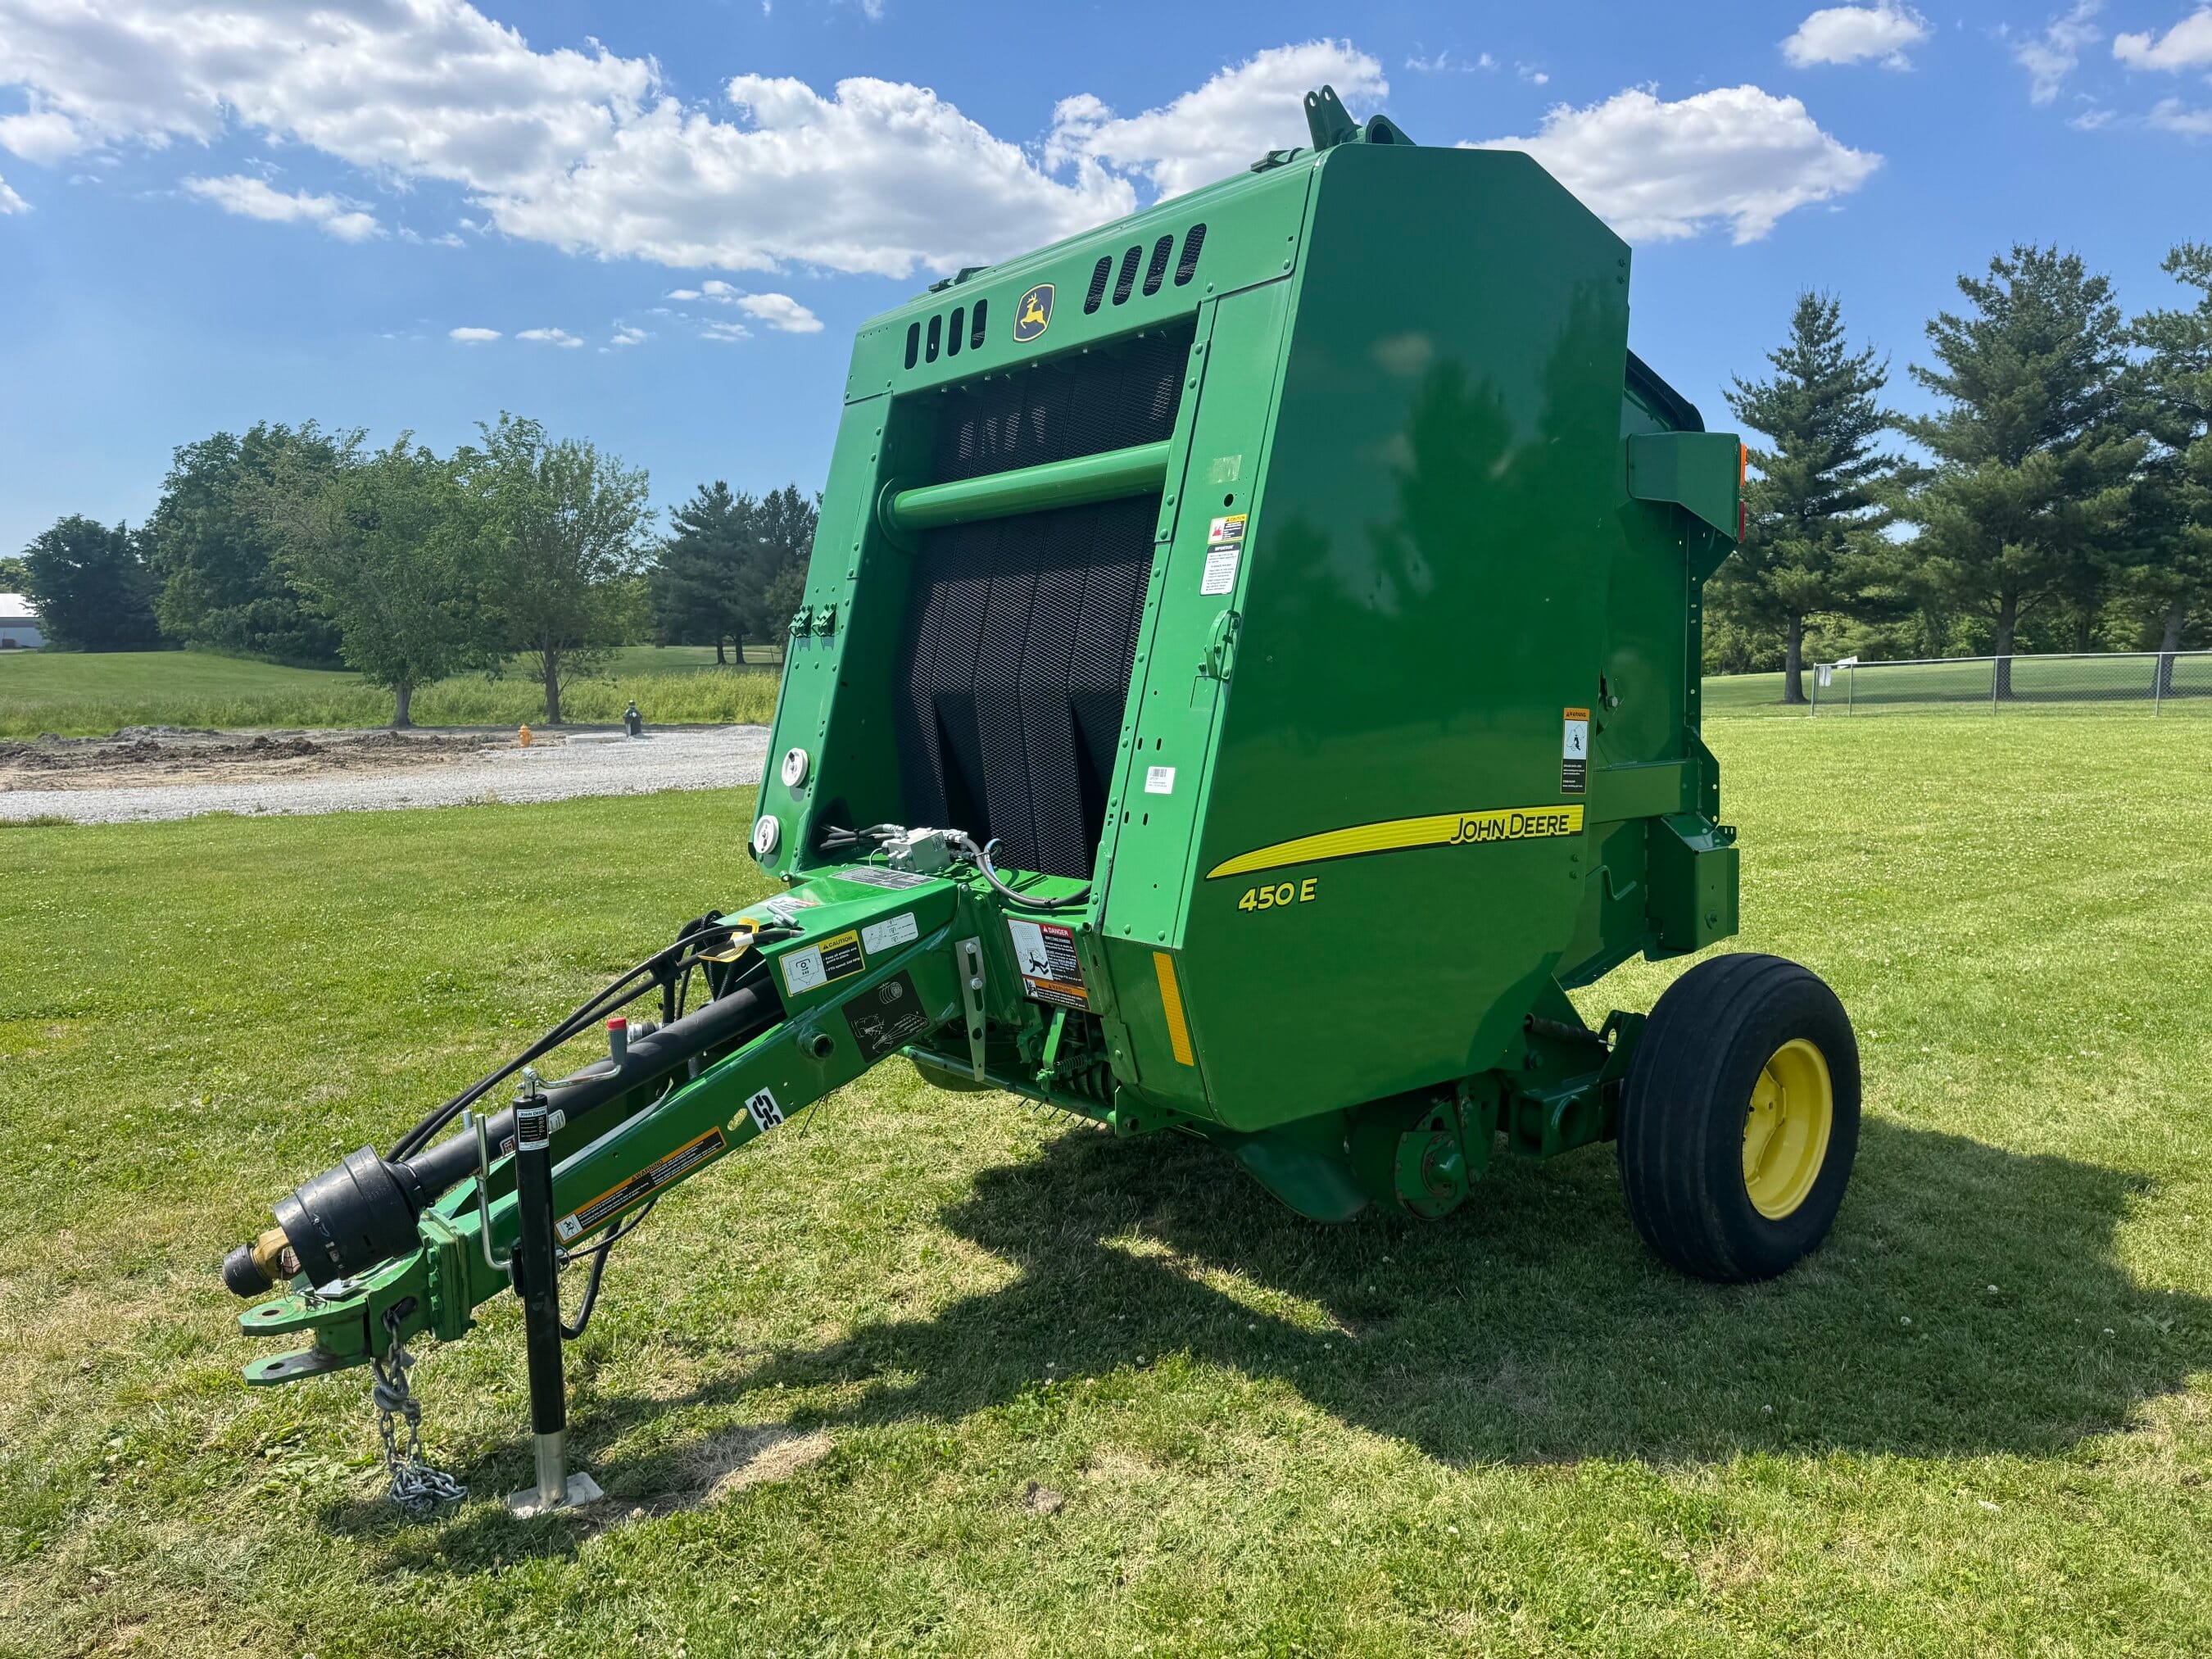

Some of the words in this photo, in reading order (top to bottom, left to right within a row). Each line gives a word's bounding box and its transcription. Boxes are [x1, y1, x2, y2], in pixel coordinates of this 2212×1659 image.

[1451, 817, 1505, 842] JOHN
[1508, 813, 1571, 837] DEERE
[1238, 881, 1294, 912] 450
[1299, 877, 1319, 903] E
[828, 936, 853, 948] CAUTION
[1048, 927, 1069, 936] DANGER
[635, 1159, 664, 1180] WARNING
